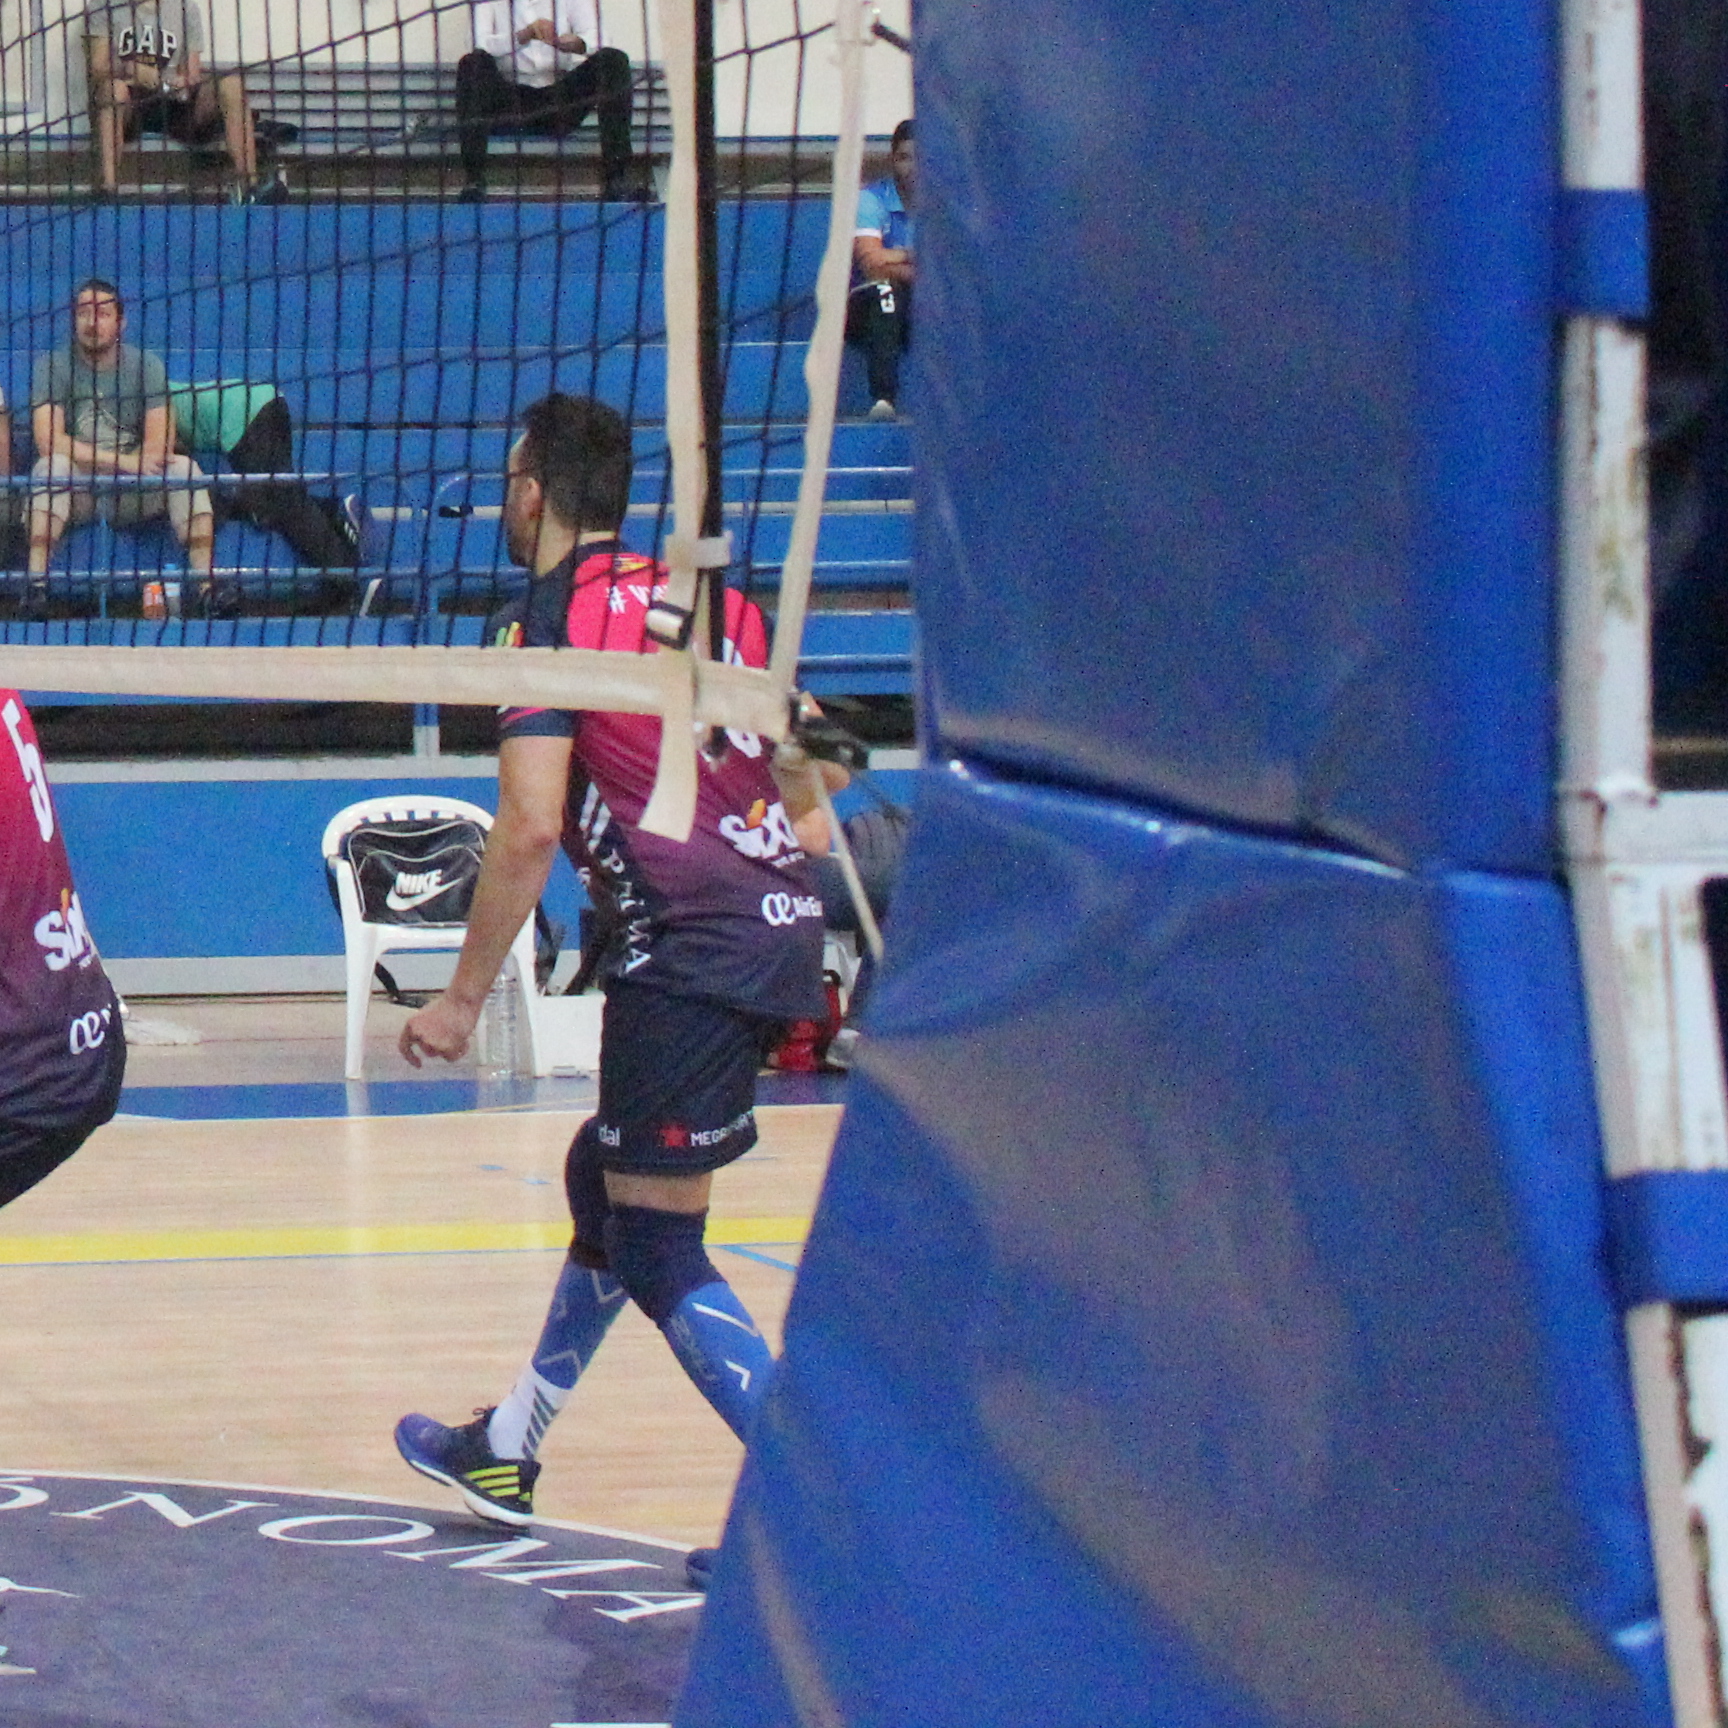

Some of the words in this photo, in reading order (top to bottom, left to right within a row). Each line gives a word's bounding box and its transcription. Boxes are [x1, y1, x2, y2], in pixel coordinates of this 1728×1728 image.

[118, 24, 178, 60] GAP
[0, 697, 55, 844] 5
[395, 868, 443, 897] NIKE
